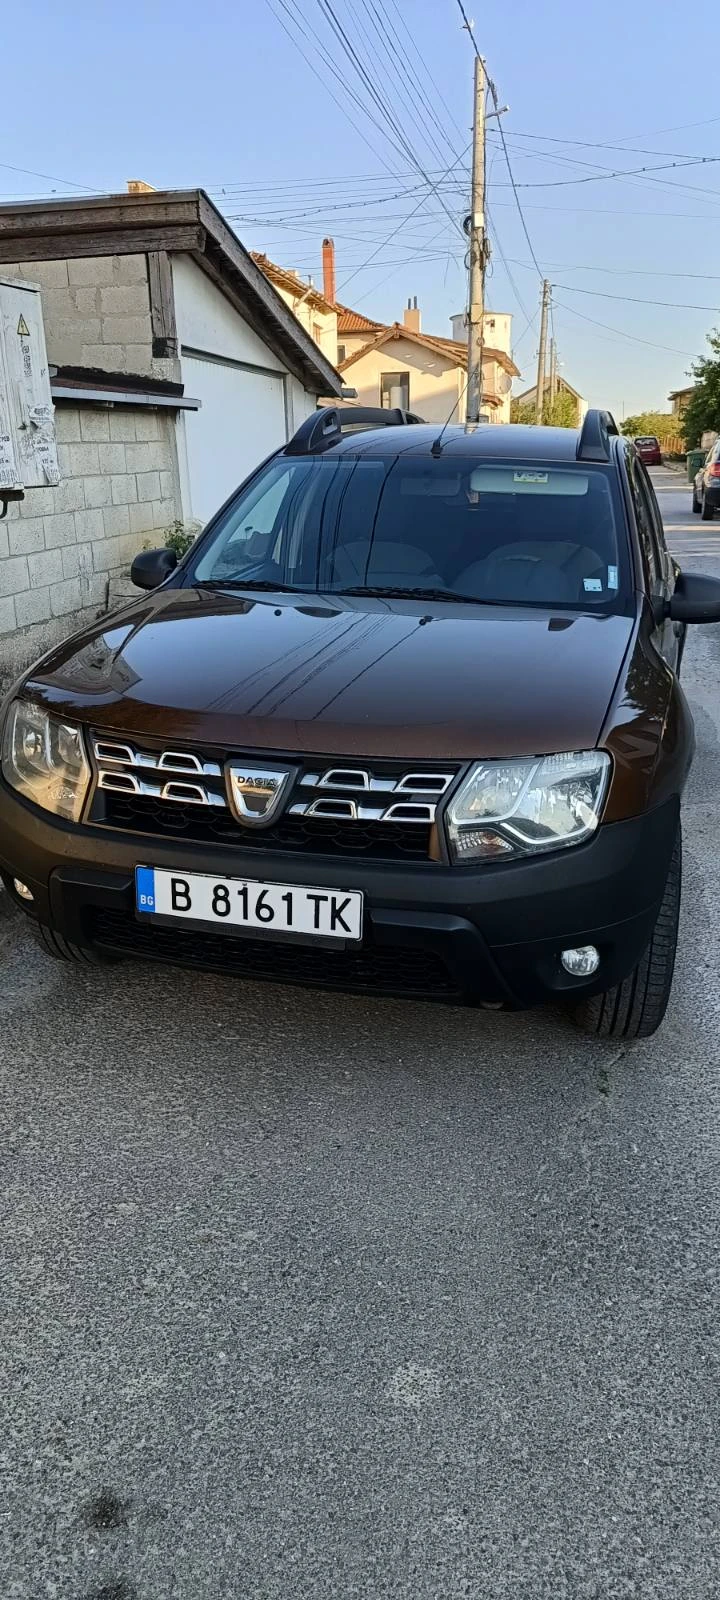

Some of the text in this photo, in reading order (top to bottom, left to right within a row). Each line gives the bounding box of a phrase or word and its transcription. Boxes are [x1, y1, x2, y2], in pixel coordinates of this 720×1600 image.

[237, 775, 277, 787] DACIA
[140, 894, 154, 906] BG
[171, 877, 352, 933] B 8161 TK
